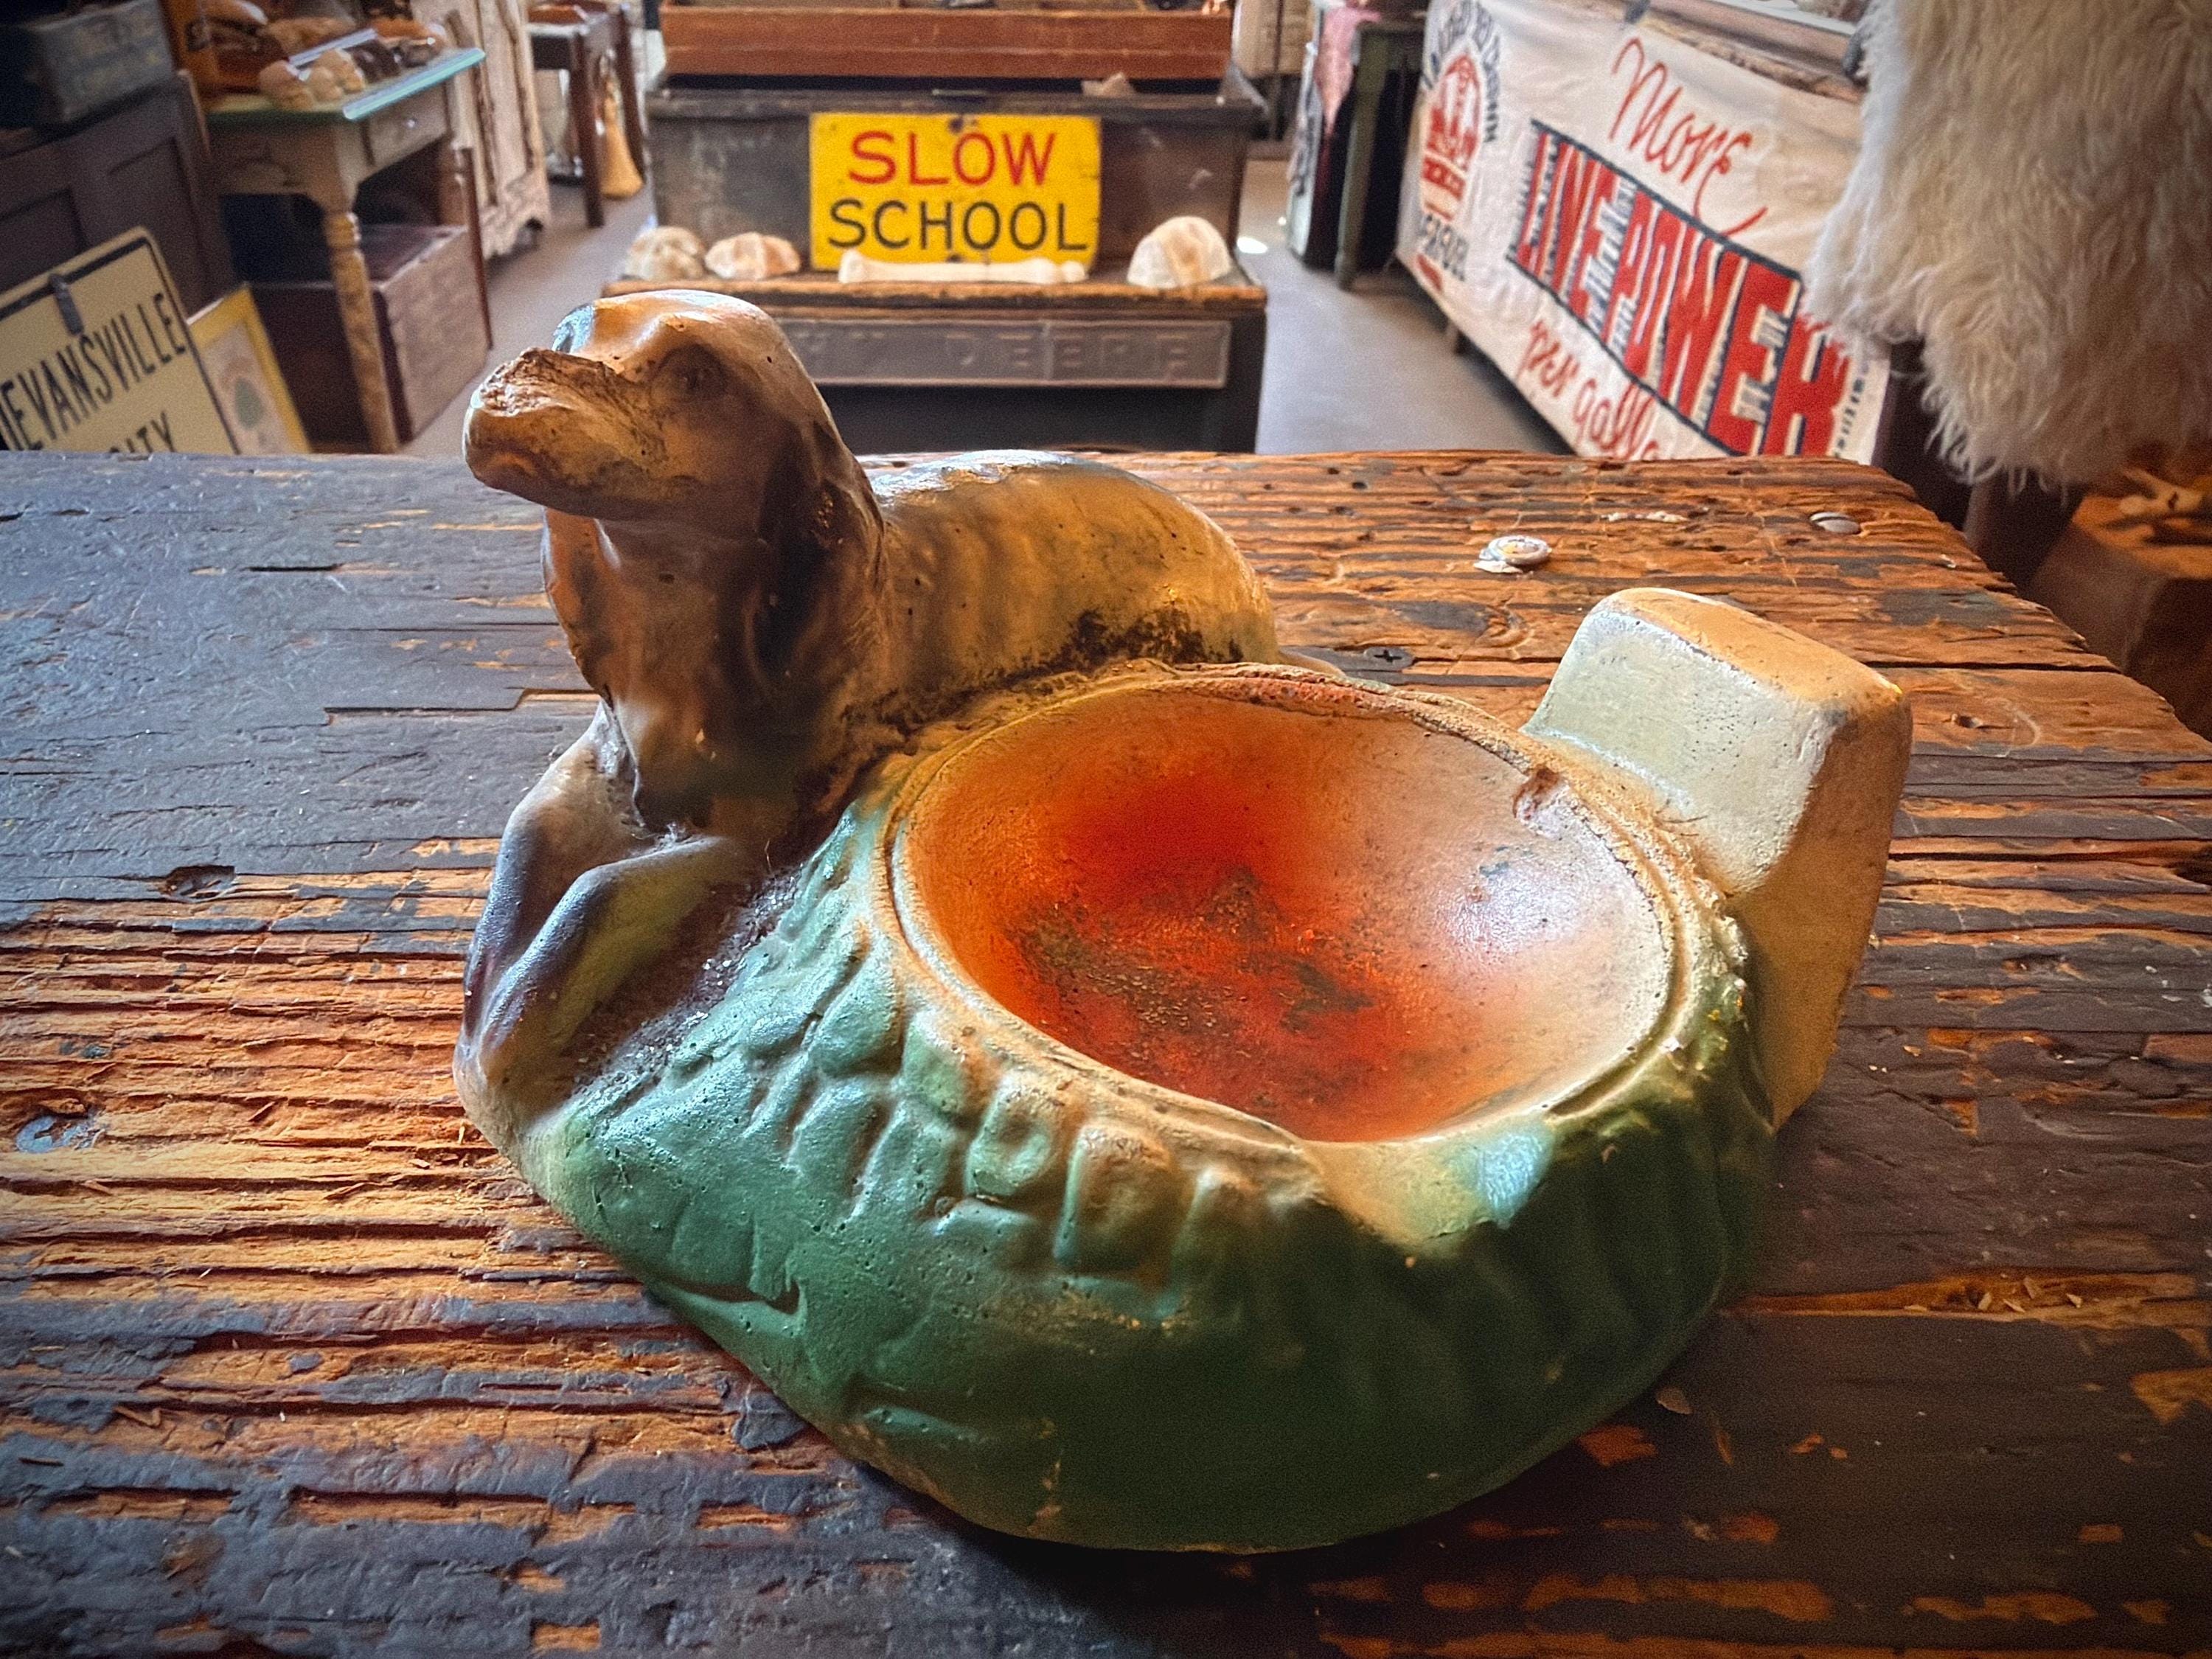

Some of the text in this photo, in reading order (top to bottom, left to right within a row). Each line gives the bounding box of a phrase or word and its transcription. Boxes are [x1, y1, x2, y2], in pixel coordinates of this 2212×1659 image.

[848, 130, 1057, 187] SLOW
[1607, 37, 1769, 237] More
[827, 197, 1088, 251] SCHOOL
[1599, 189, 1851, 456] POWER
